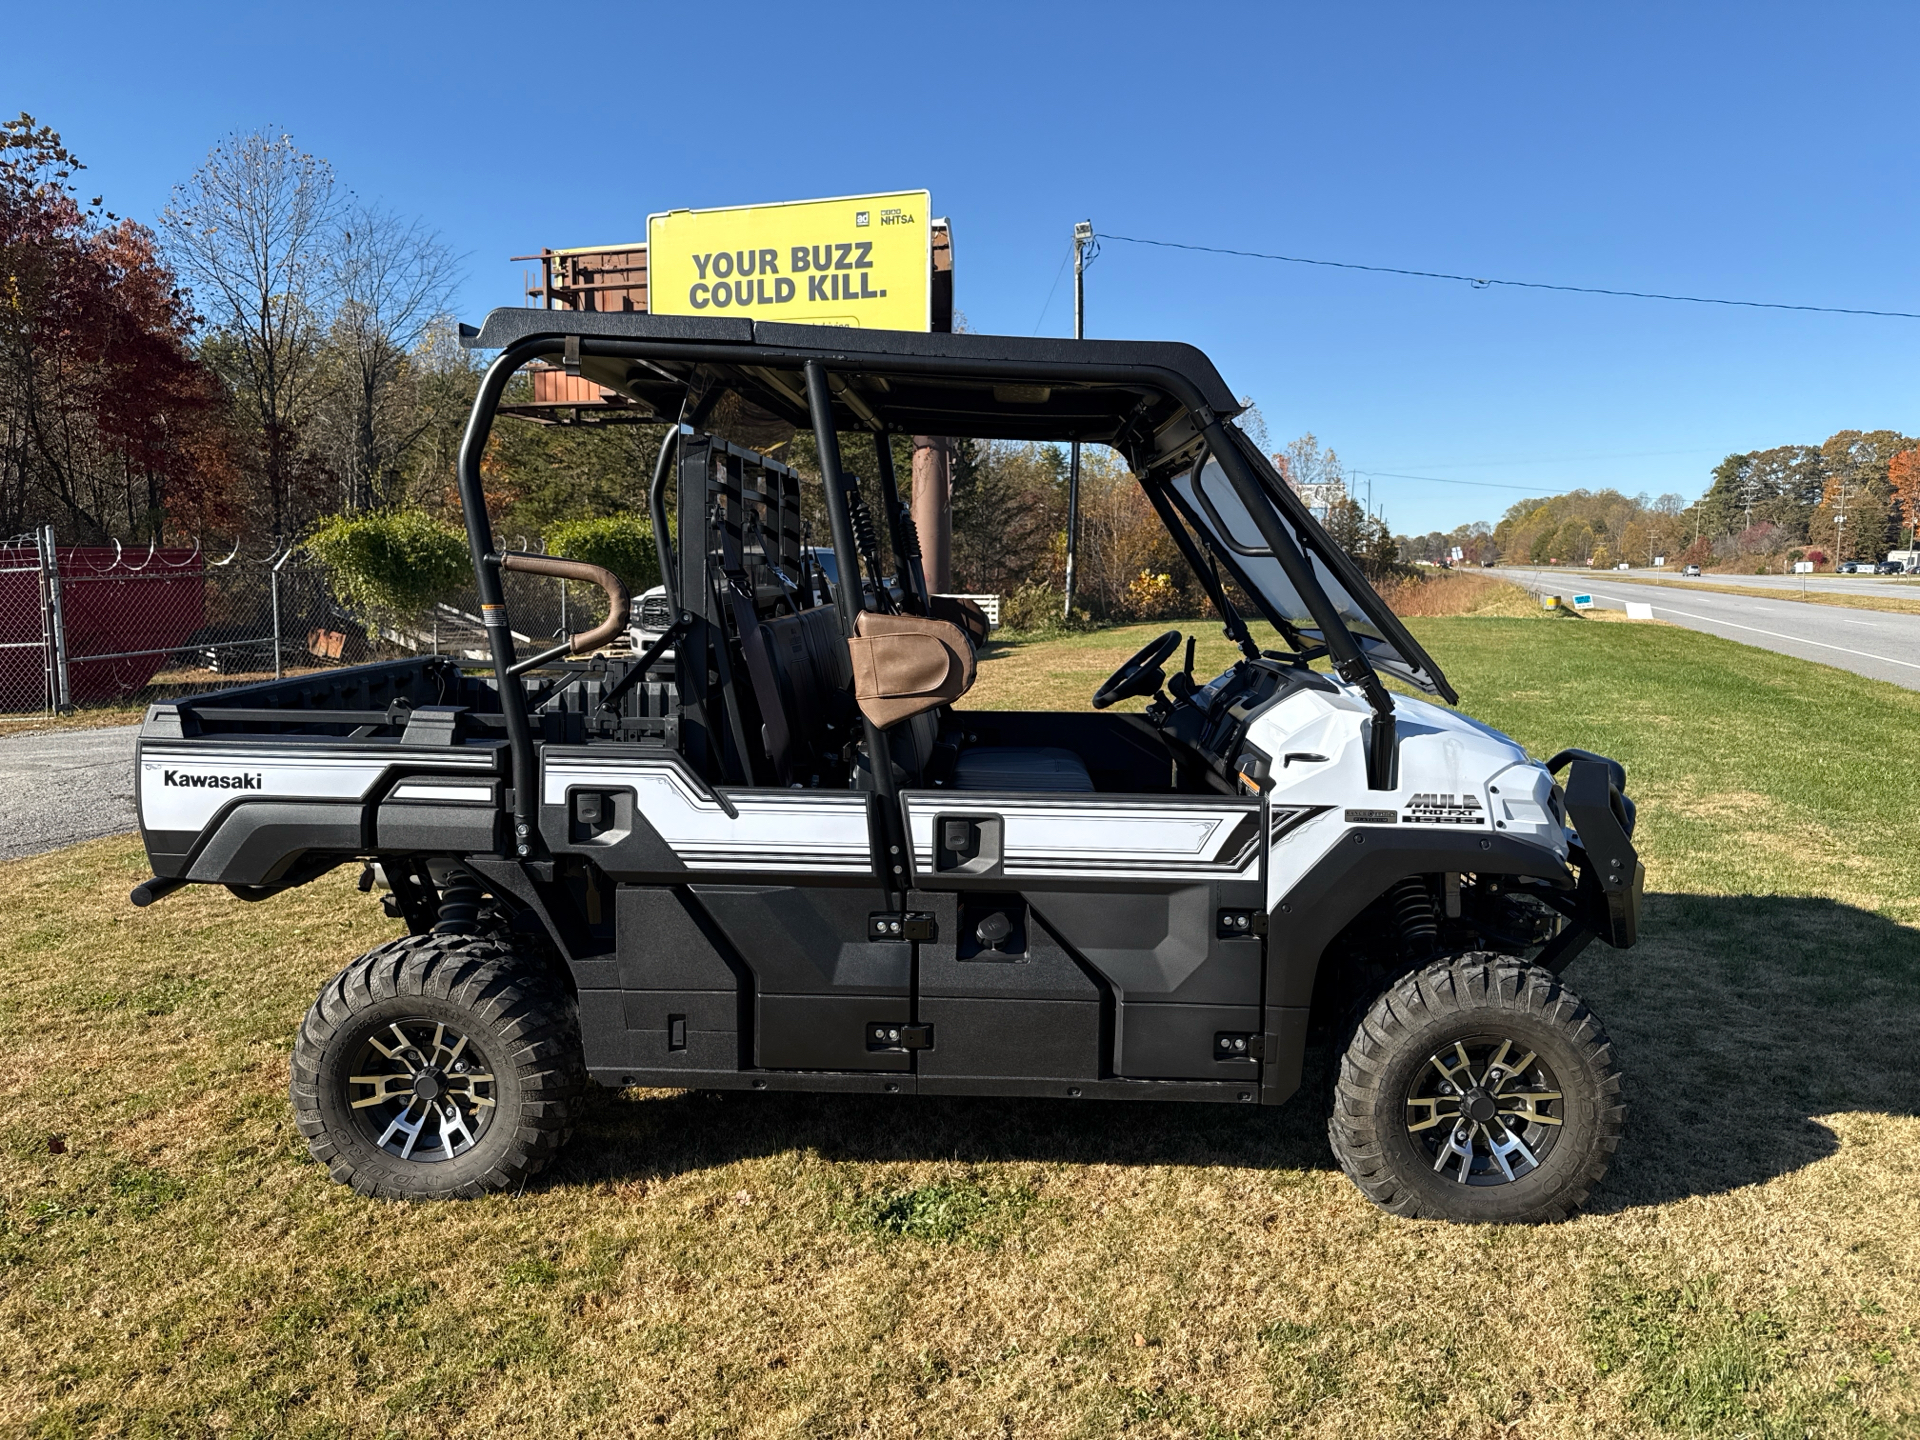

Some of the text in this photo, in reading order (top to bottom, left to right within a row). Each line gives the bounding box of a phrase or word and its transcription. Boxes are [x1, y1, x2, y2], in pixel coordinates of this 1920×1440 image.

[880, 214, 915, 226] NHTSA
[692, 241, 873, 280] YOUR BUZZ
[689, 272, 887, 309] COULD KILL.
[164, 769, 262, 790] Kawasaki
[1404, 793, 1483, 810] MULE
[1409, 816, 1477, 824] 1000
